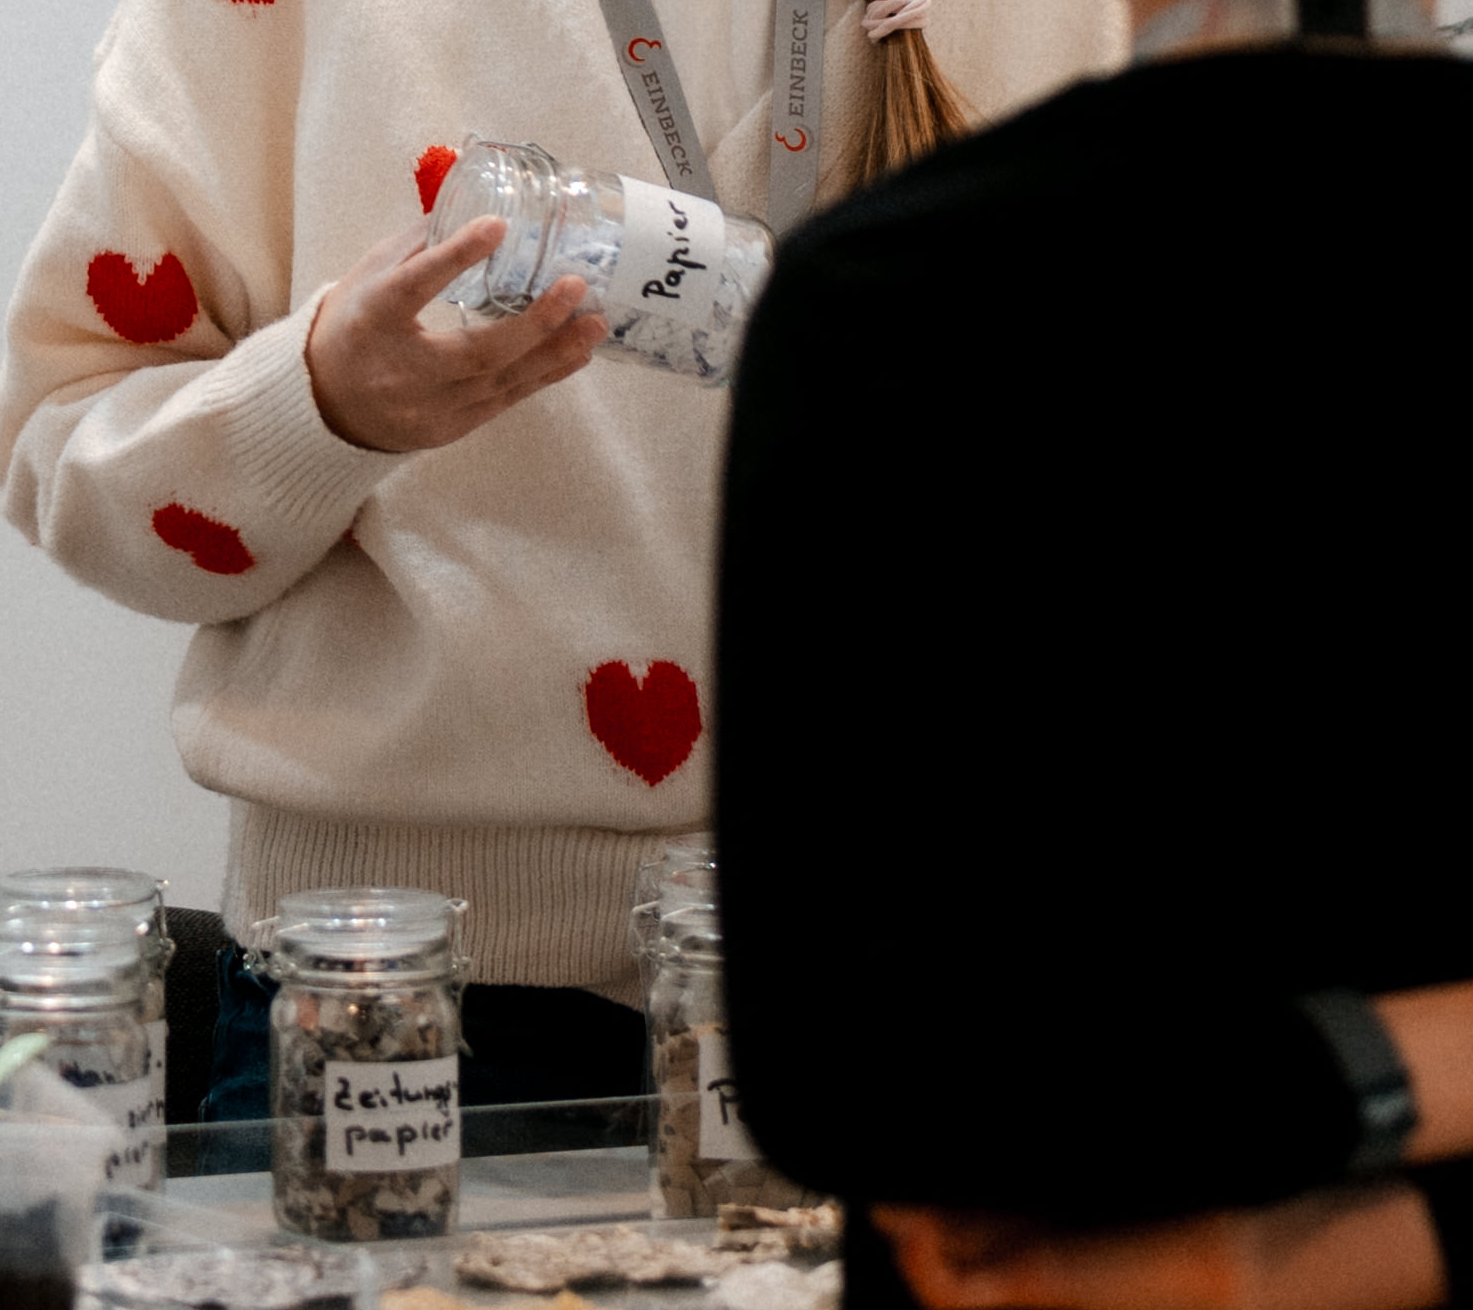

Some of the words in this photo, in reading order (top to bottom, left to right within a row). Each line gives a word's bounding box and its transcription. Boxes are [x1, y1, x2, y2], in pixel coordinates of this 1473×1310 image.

[789, 9, 809, 118] EINBECK
[641, 71, 693, 177] EINBECK
[642, 200, 707, 299] Papier
[345, 1120, 453, 1156] papier
